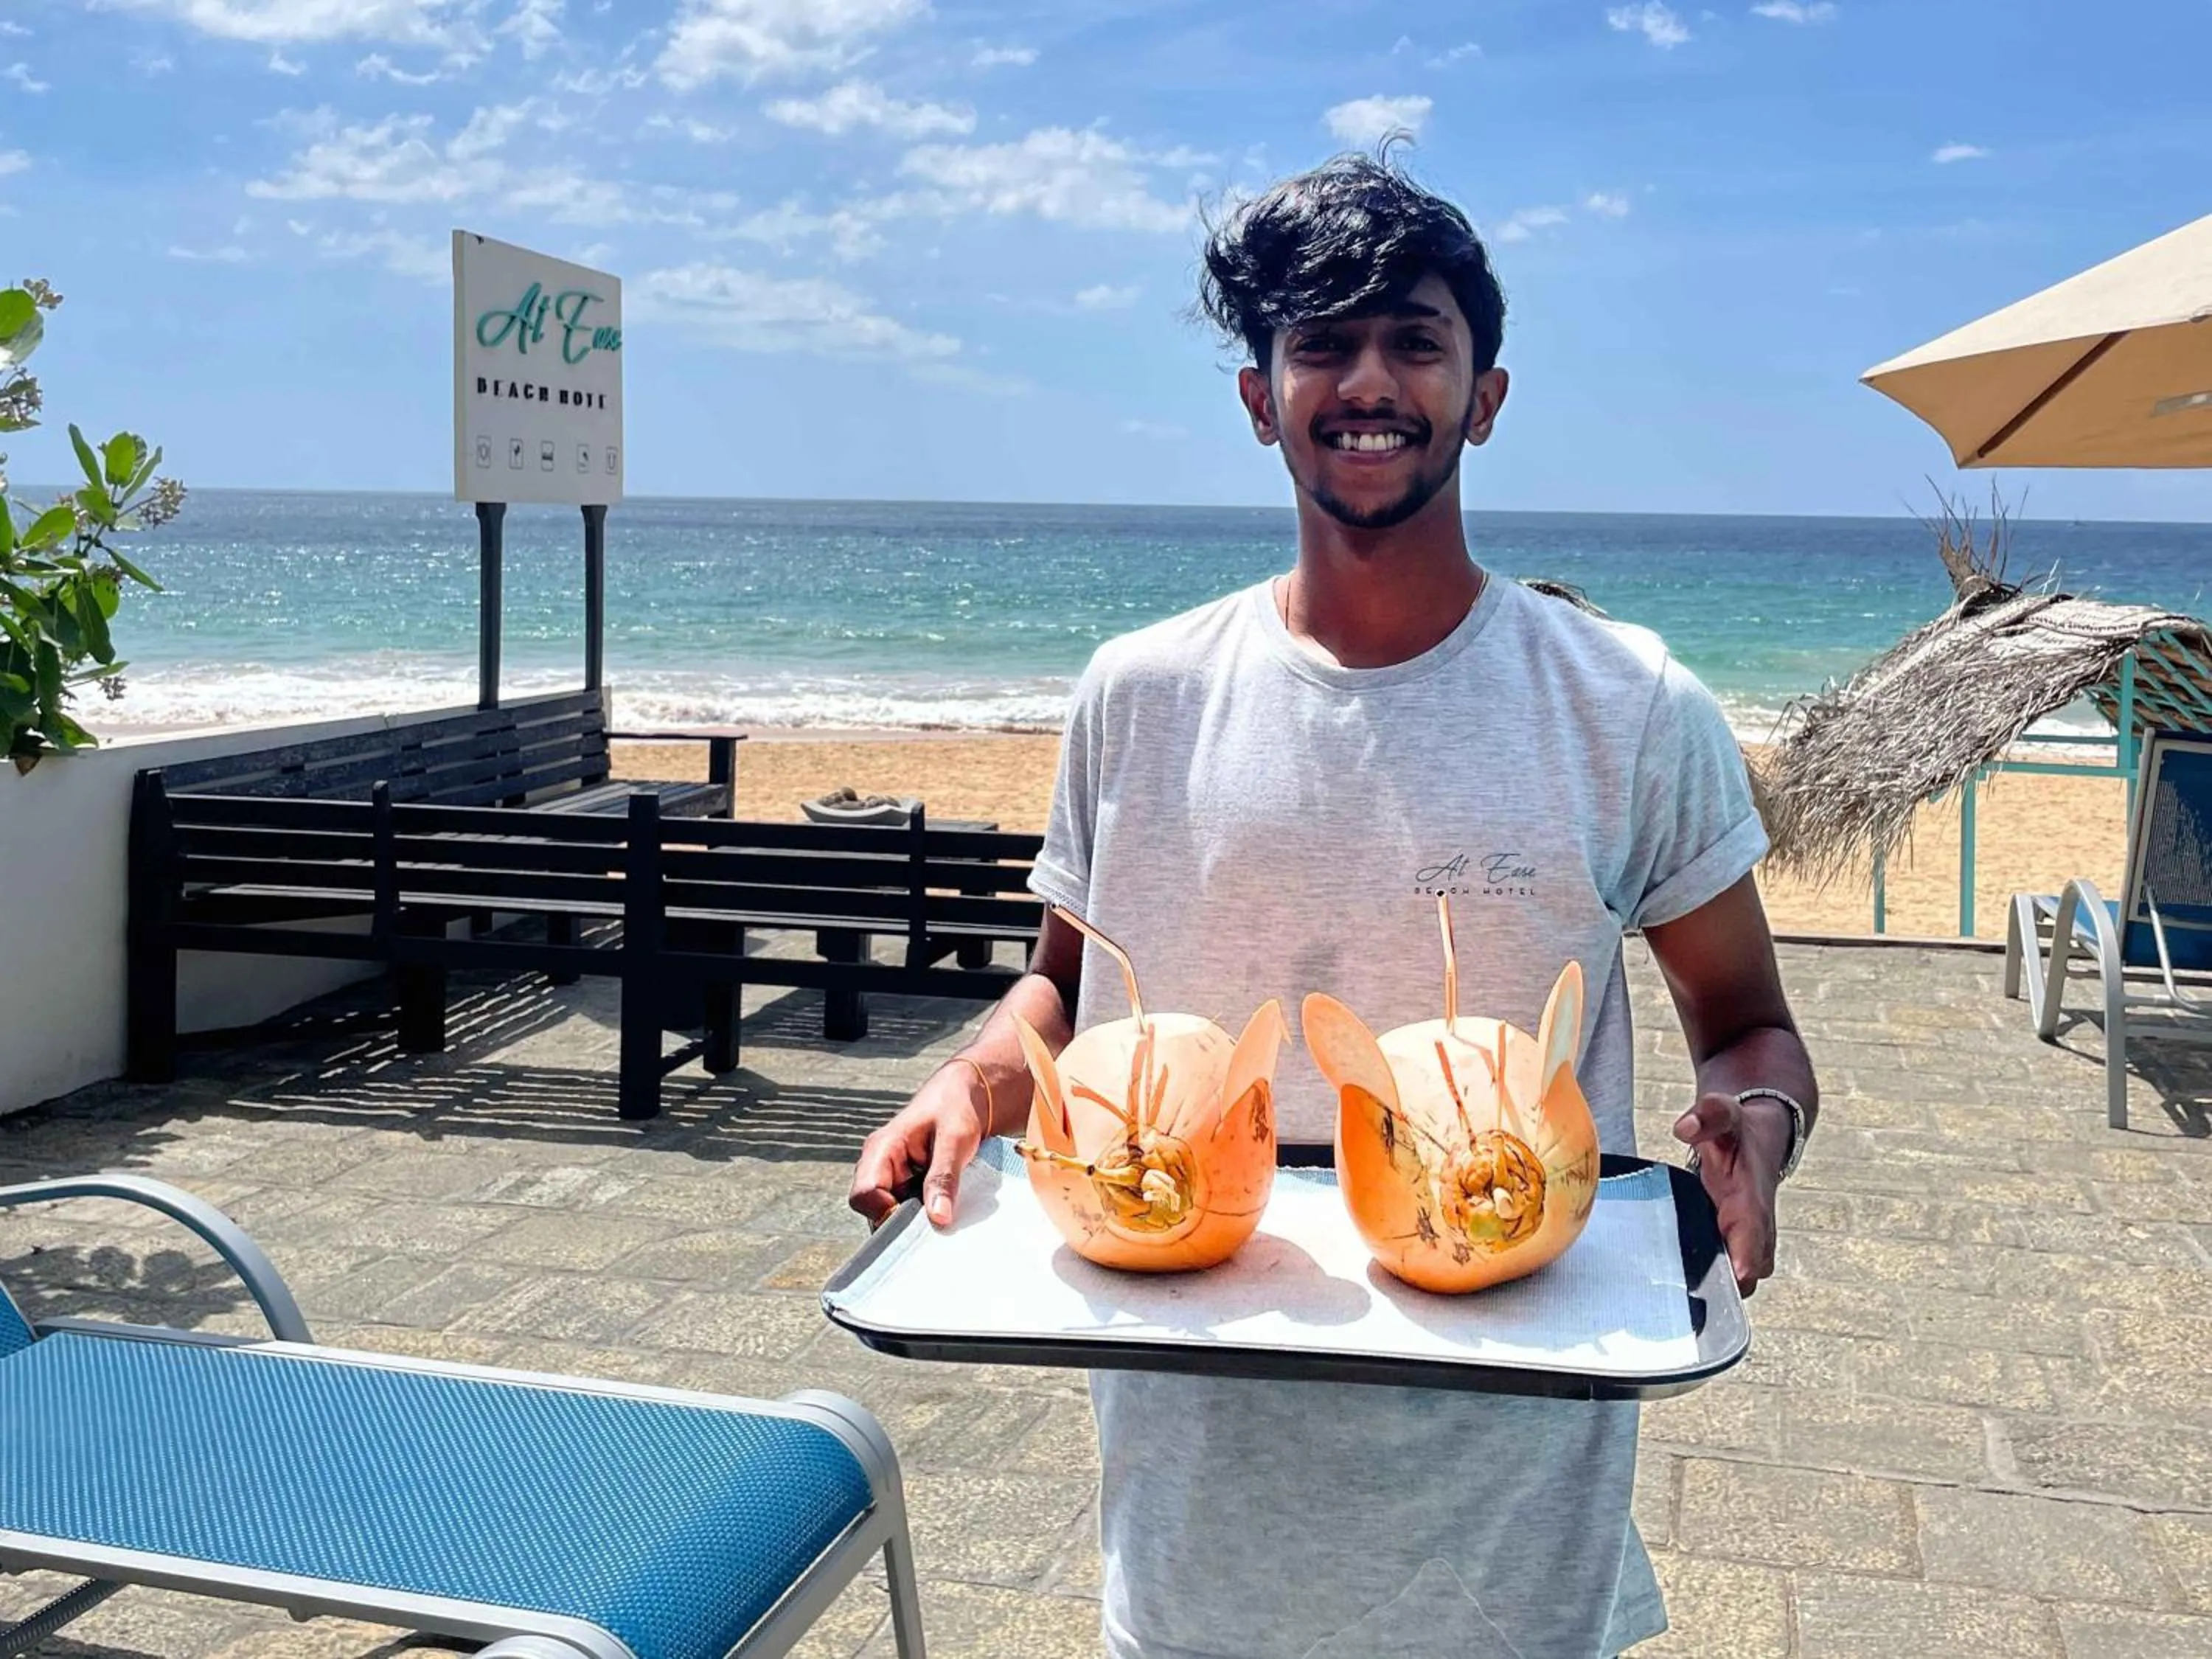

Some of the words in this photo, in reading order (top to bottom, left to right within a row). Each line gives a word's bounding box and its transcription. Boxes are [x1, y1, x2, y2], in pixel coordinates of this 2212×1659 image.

[476, 282, 551, 355] At
[477, 377, 549, 403] BEACH
[1415, 853, 1470, 883] At
[1480, 853, 1537, 884] Ease
[1414, 887, 1470, 895] BECH
[1483, 887, 1535, 896] HOTEL
